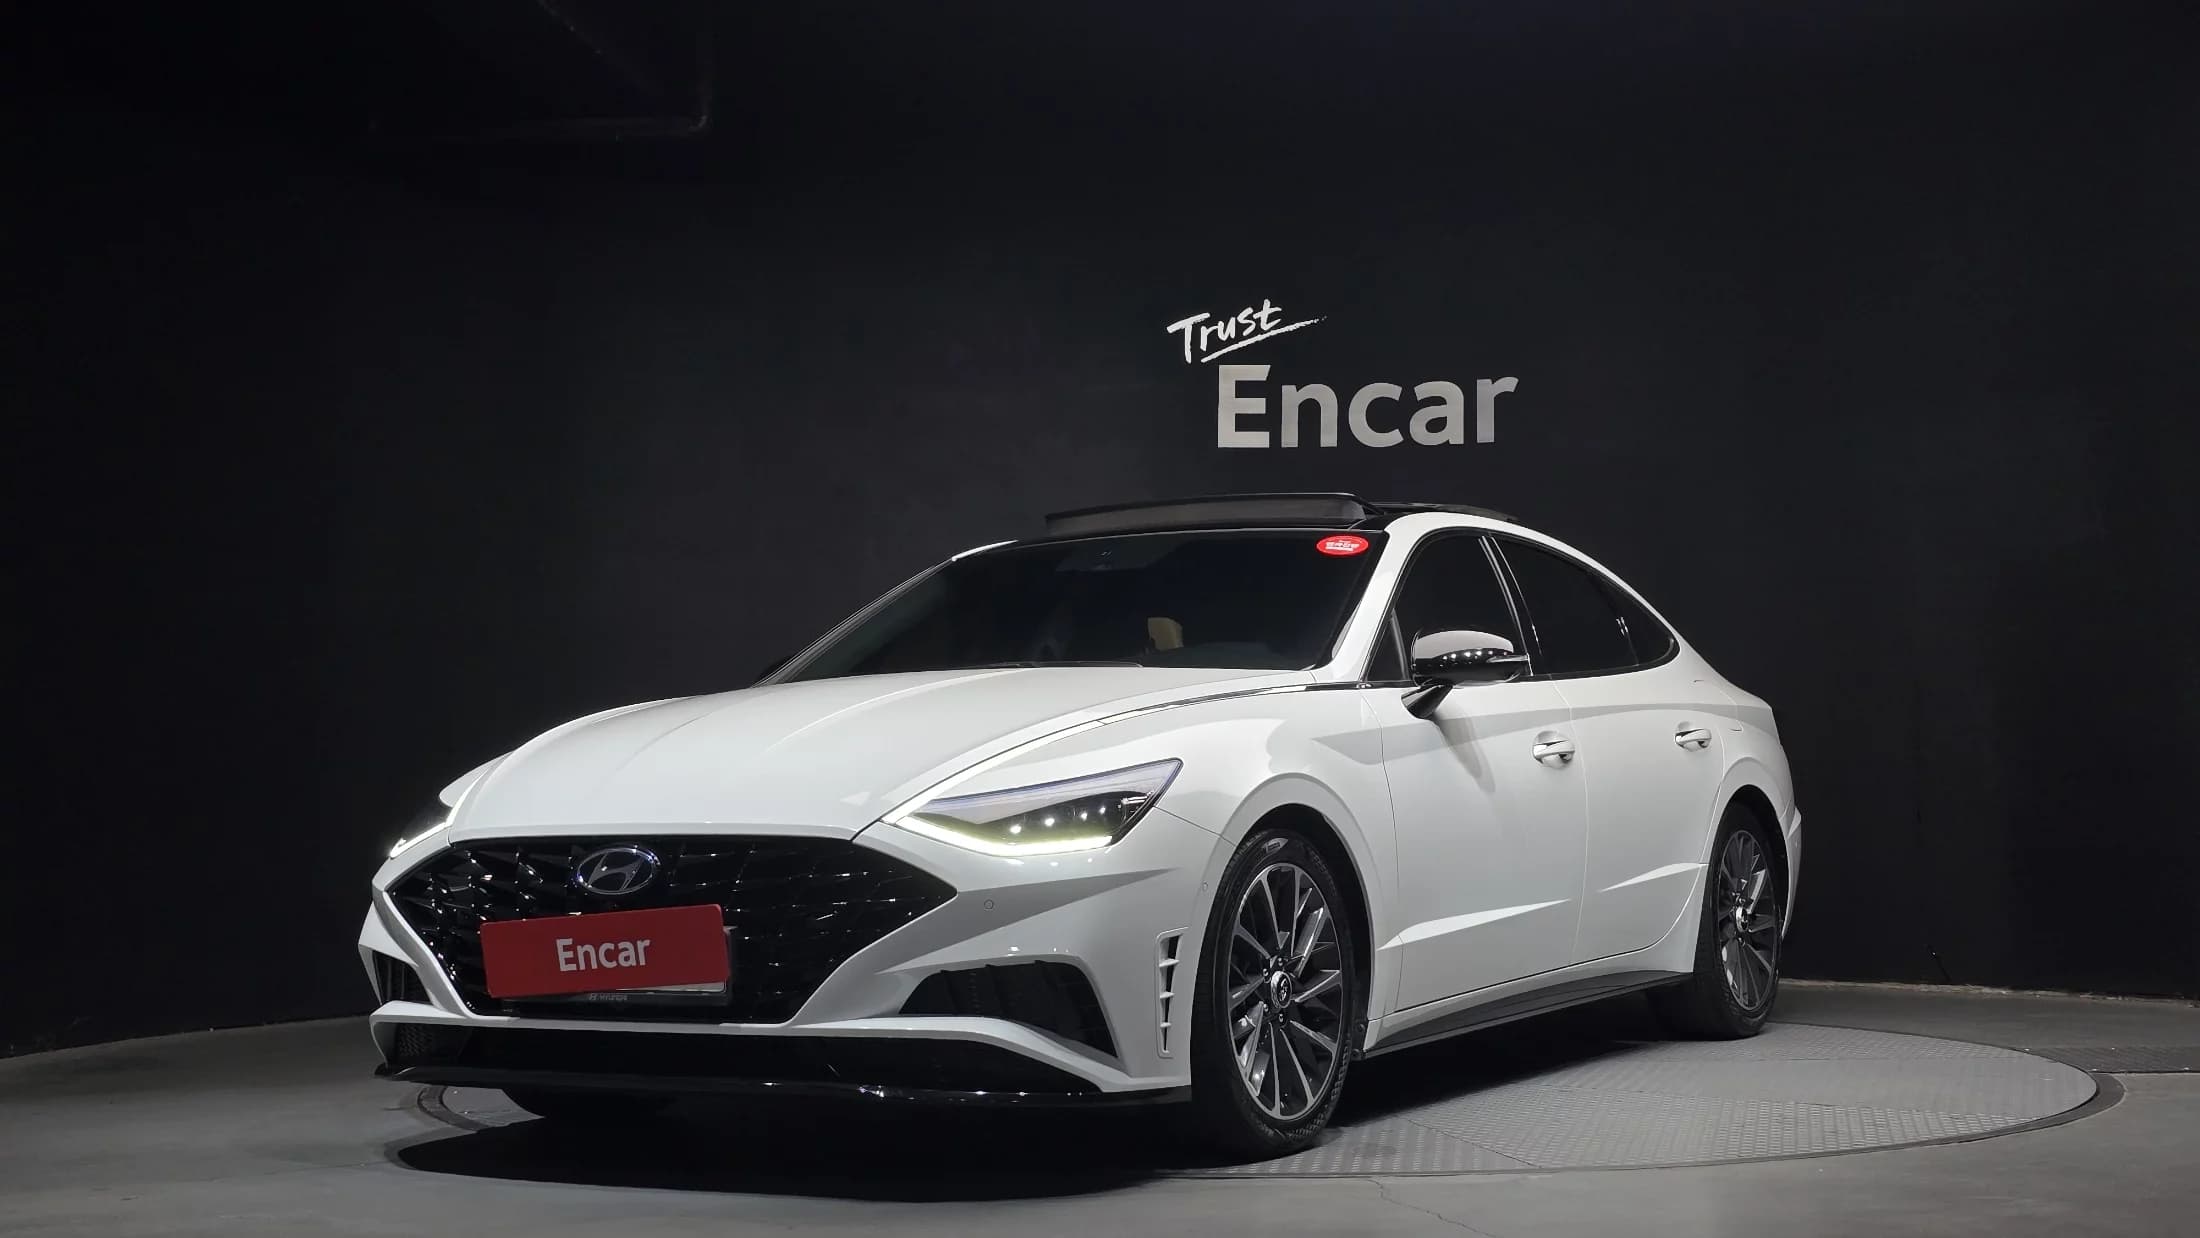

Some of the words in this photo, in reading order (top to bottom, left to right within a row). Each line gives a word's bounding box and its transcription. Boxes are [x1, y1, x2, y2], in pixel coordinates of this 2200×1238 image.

[1166, 299, 1283, 363] Trust
[1217, 364, 1519, 448] Encar
[556, 938, 650, 971] Encar
